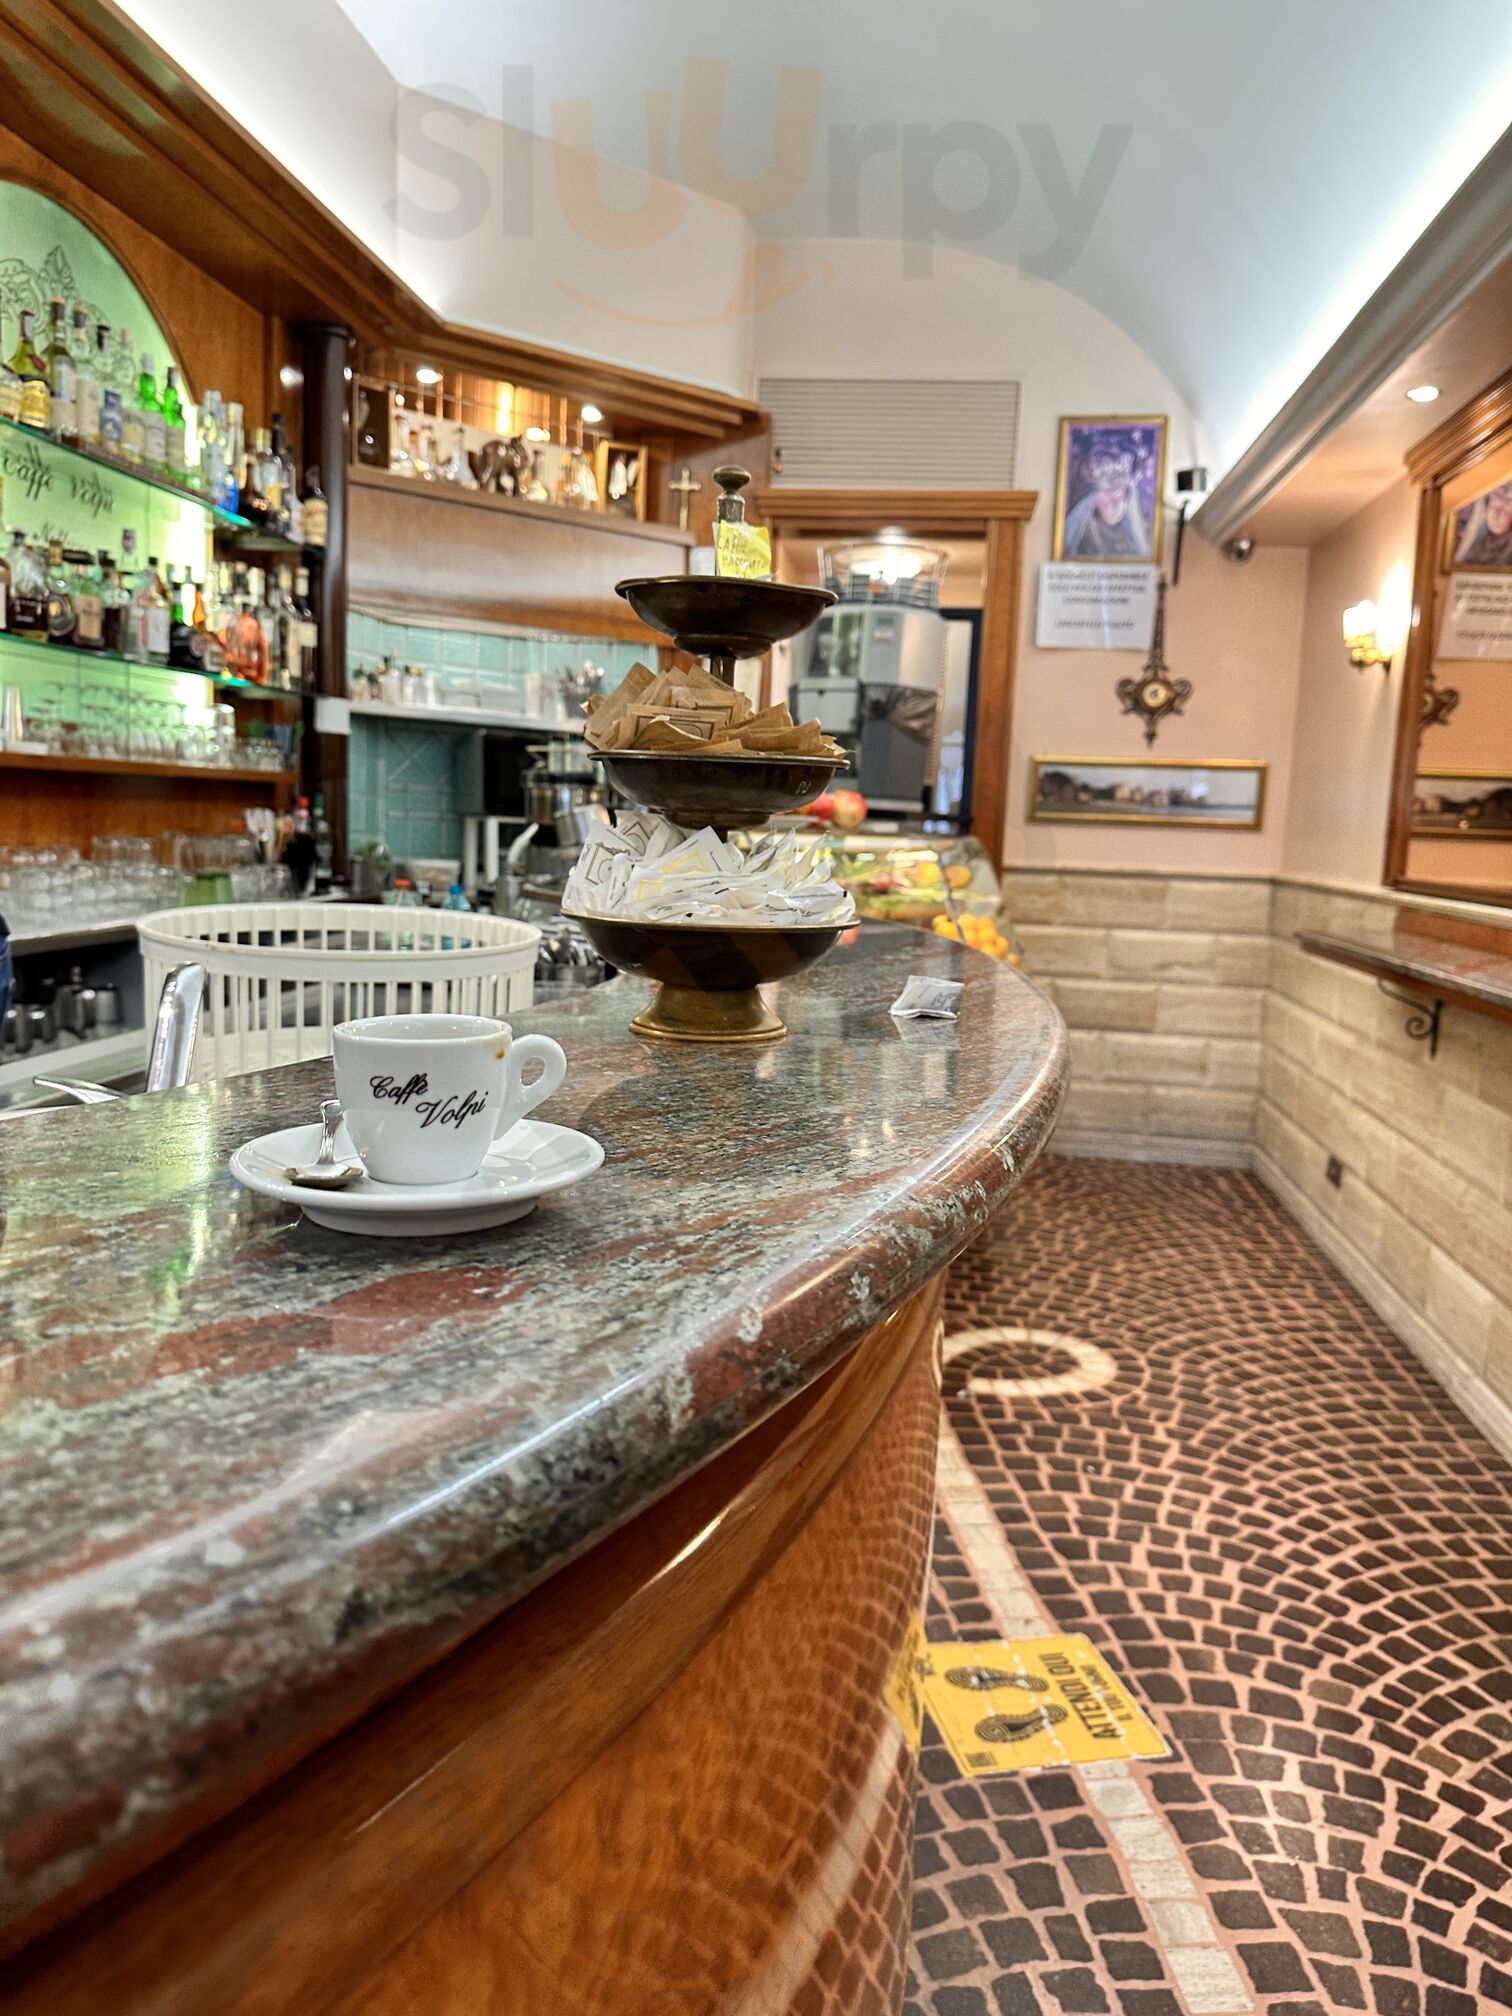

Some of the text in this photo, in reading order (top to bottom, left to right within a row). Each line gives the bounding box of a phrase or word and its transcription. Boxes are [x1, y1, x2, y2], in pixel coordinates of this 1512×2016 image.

[415, 1090, 489, 1130] Volpi
[1038, 1652, 1075, 1676] QUI
[1056, 1678, 1122, 1739] ATTENDI
